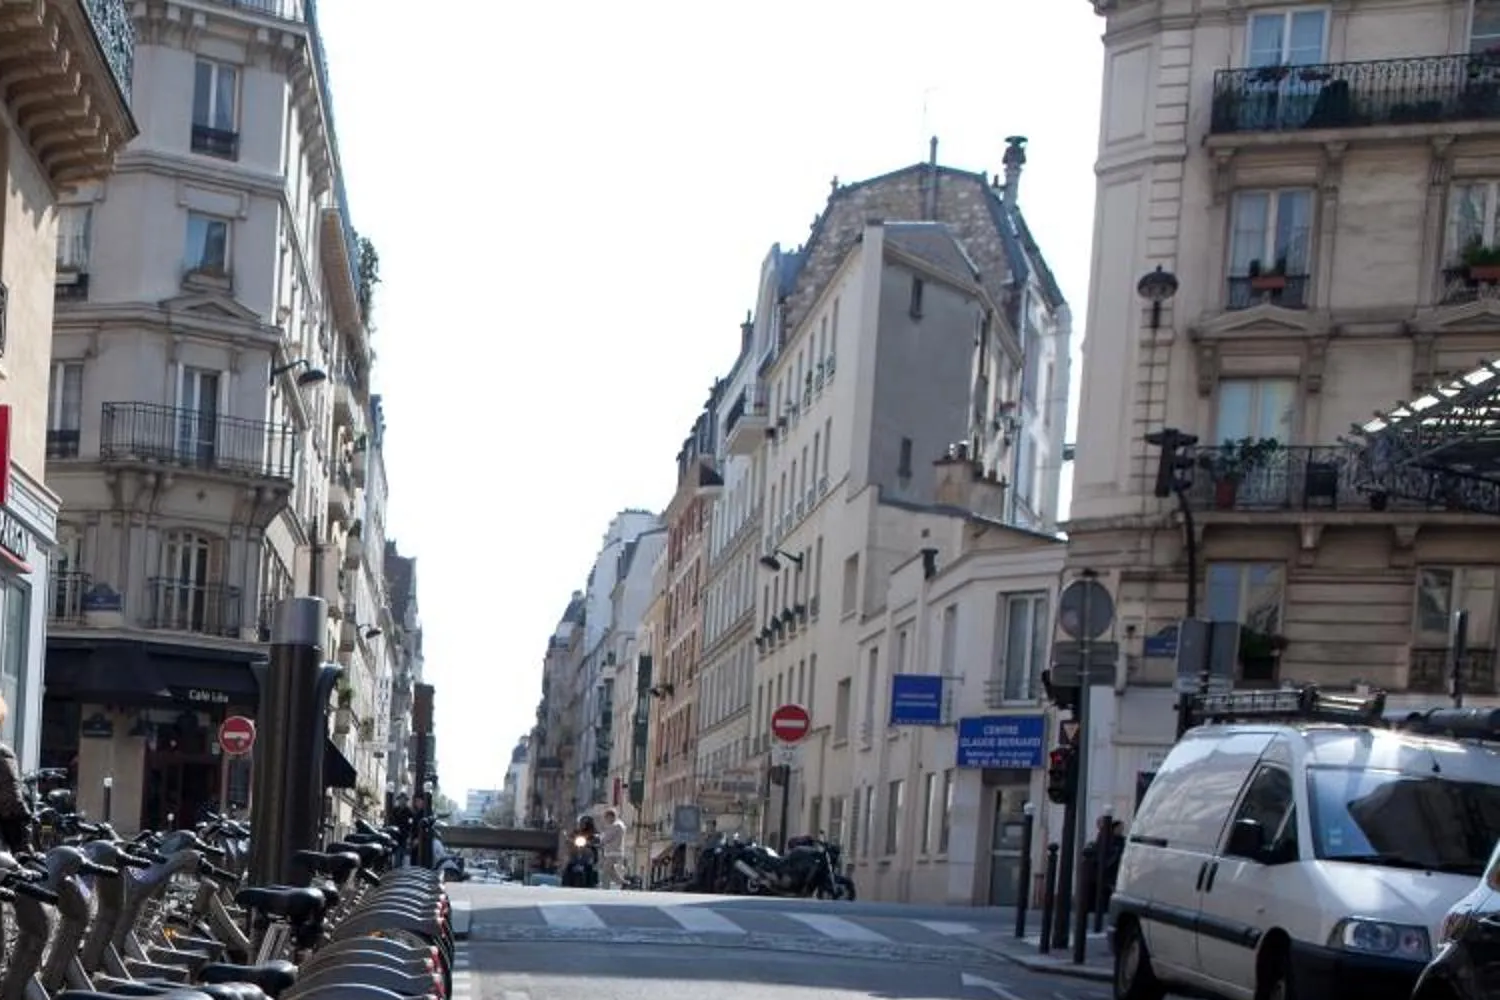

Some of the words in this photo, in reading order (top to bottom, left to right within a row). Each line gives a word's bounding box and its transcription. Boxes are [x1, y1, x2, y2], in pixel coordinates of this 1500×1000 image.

[188, 689, 210, 702] Café
[983, 724, 1019, 736] CENTRE
[960, 737, 995, 748] CLAUDE
[997, 736, 1041, 748] BERNARD
